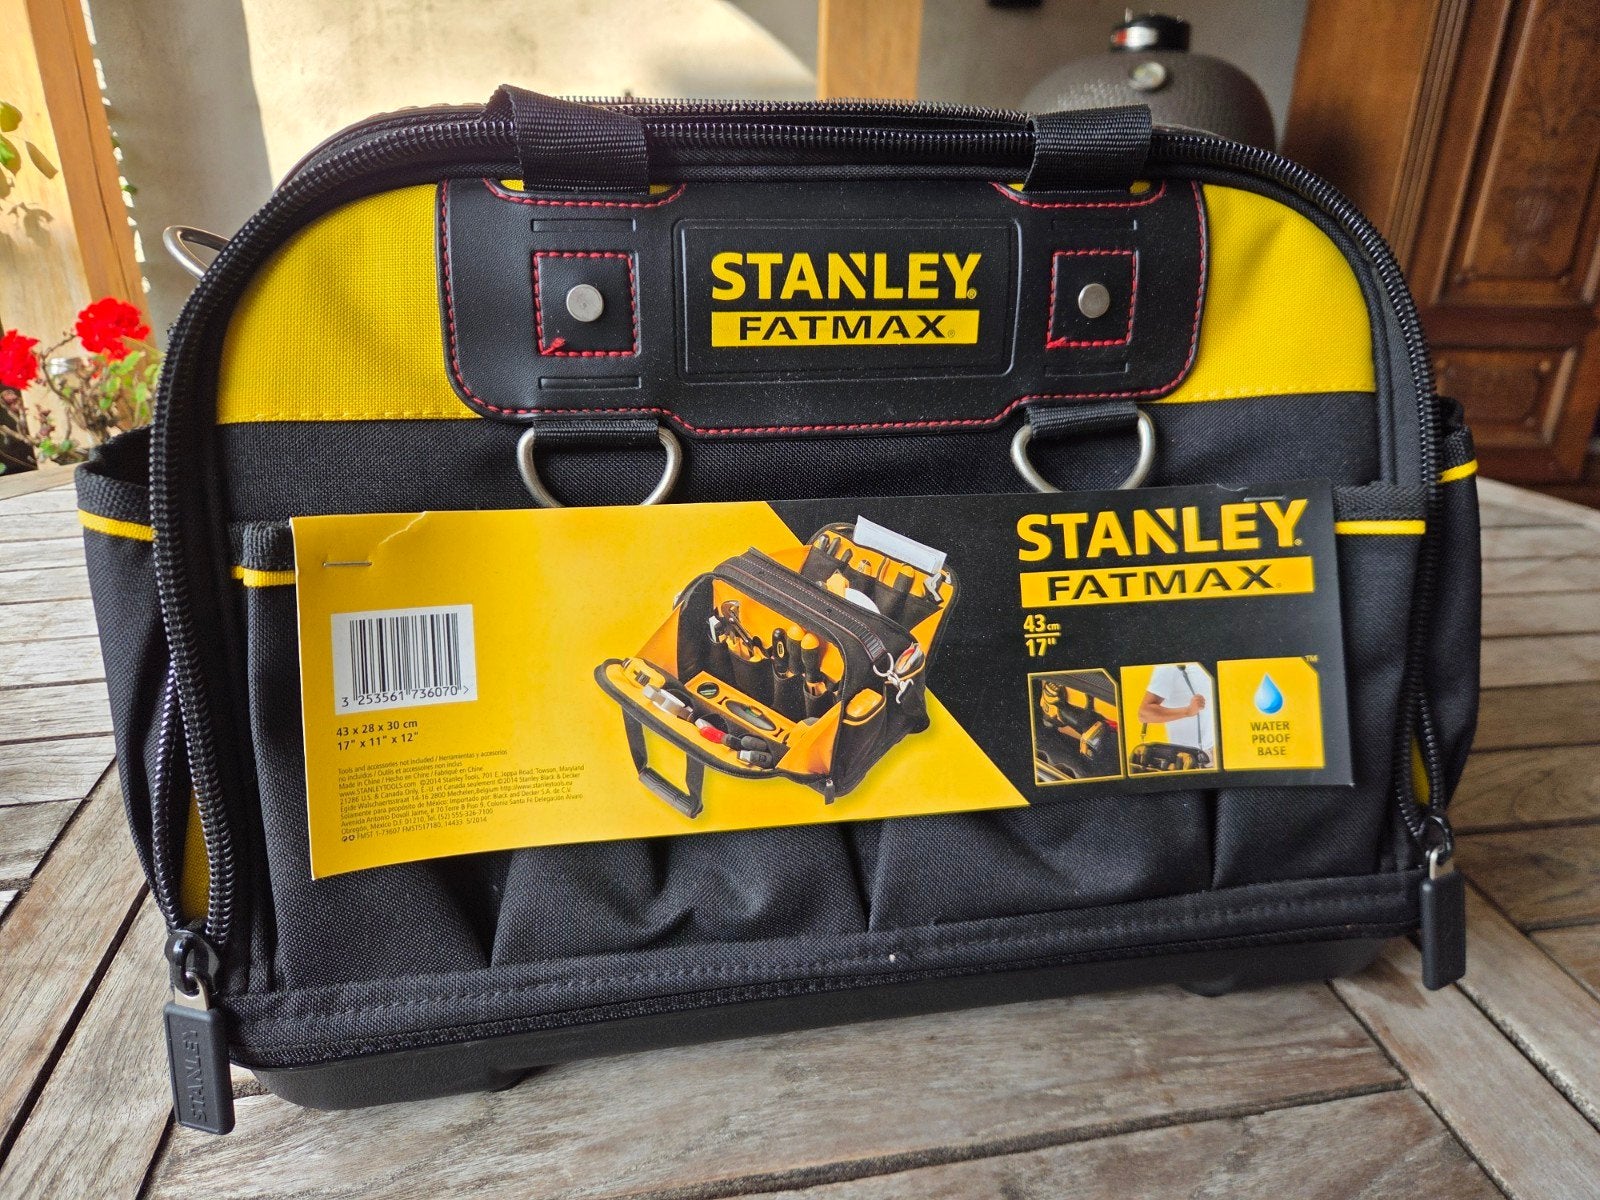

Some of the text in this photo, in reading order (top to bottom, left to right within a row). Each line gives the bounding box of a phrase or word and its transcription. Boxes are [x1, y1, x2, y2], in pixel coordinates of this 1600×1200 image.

[341, 696, 349, 708] 3
[358, 691, 405, 706] 253561
[411, 685, 458, 699] 736070
[336, 726, 349, 737] 43
[353, 727, 359, 735] x
[361, 723, 375, 734] 28
[387, 720, 400, 731] 30
[403, 720, 418, 729] cm
[1250, 721, 1290, 732] WATER
[337, 739, 356, 751] 17"
[360, 740, 366, 748] x
[369, 735, 387, 746] 11"
[401, 731, 419, 743] 12"
[1251, 733, 1291, 744] PROOF
[1257, 746, 1287, 757] BASE
[410, 756, 434, 764] included
[442, 775, 463, 783] Stanley
[558, 763, 584, 772] Maryland
[338, 781, 355, 789] Made
[365, 814, 390, 823] Antonio
